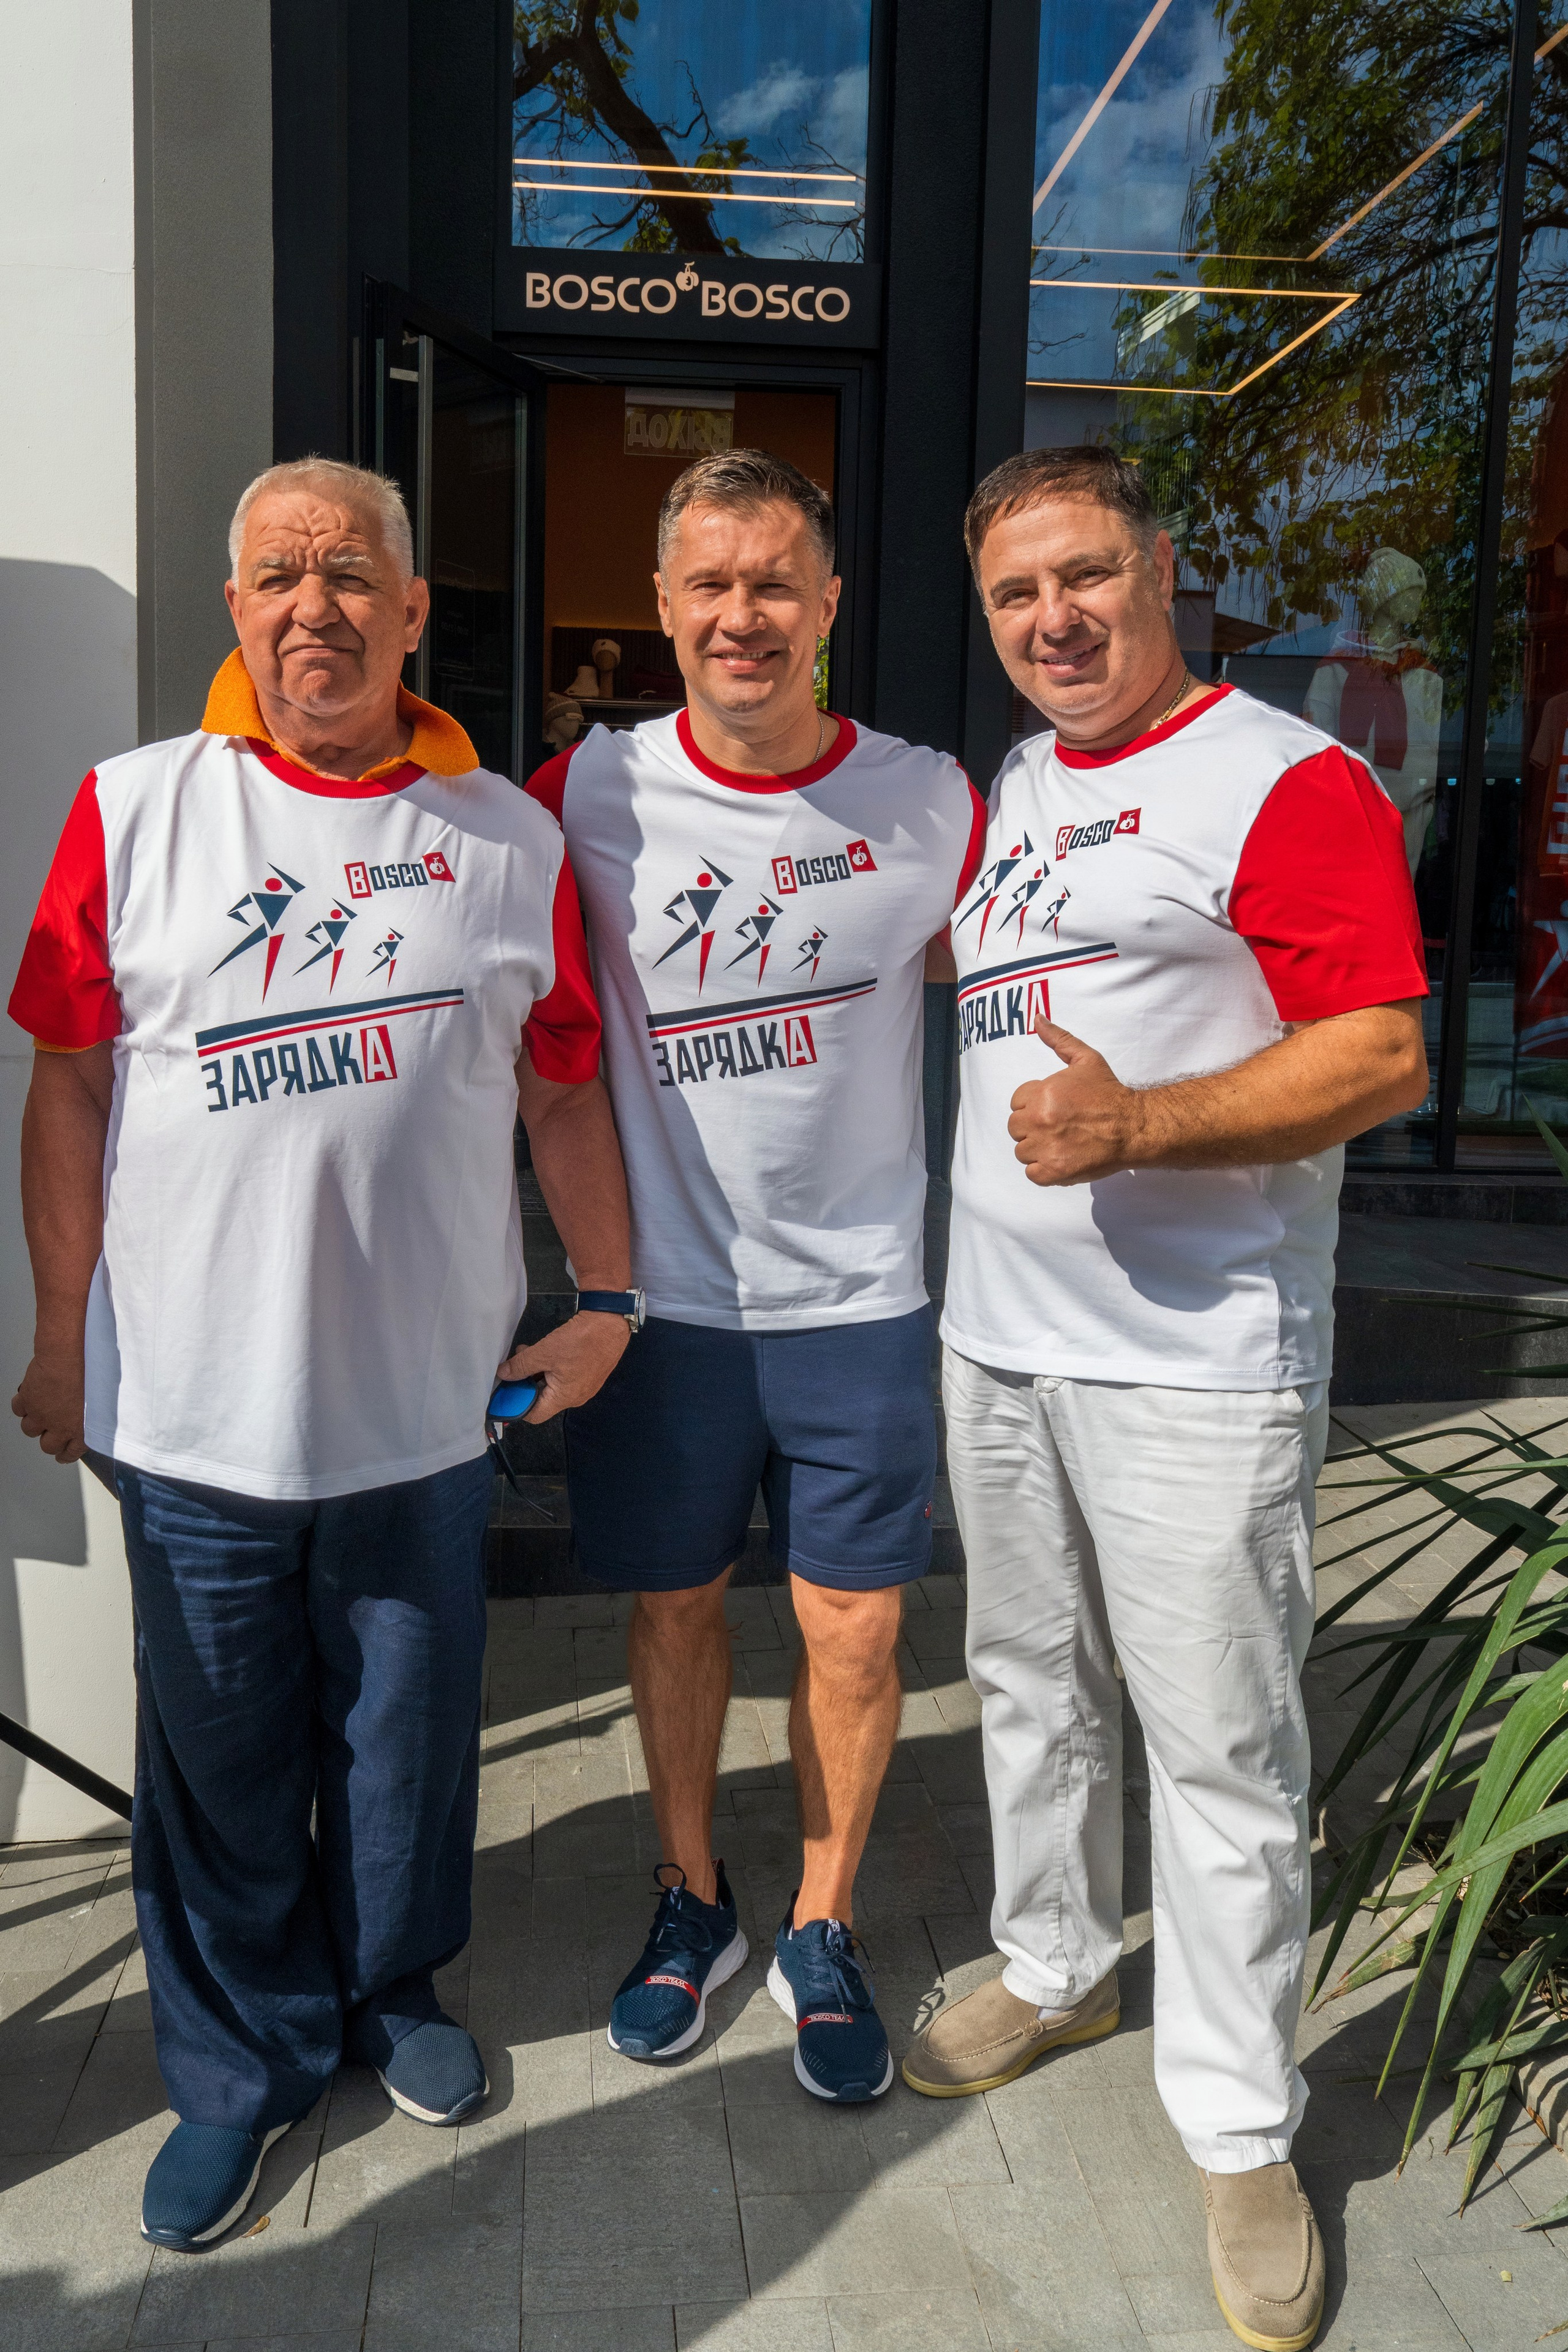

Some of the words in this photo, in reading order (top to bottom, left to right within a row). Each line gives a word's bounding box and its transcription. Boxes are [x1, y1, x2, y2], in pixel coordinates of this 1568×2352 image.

[526, 272, 677, 314] BOSCO
[701, 281, 850, 322] BOSCO
[202, 1025, 396, 1112] ЗАРЯДКА
[652, 1016, 816, 1087] ЗАРЯДКА
[667, 1977, 685, 1988] TEAM
